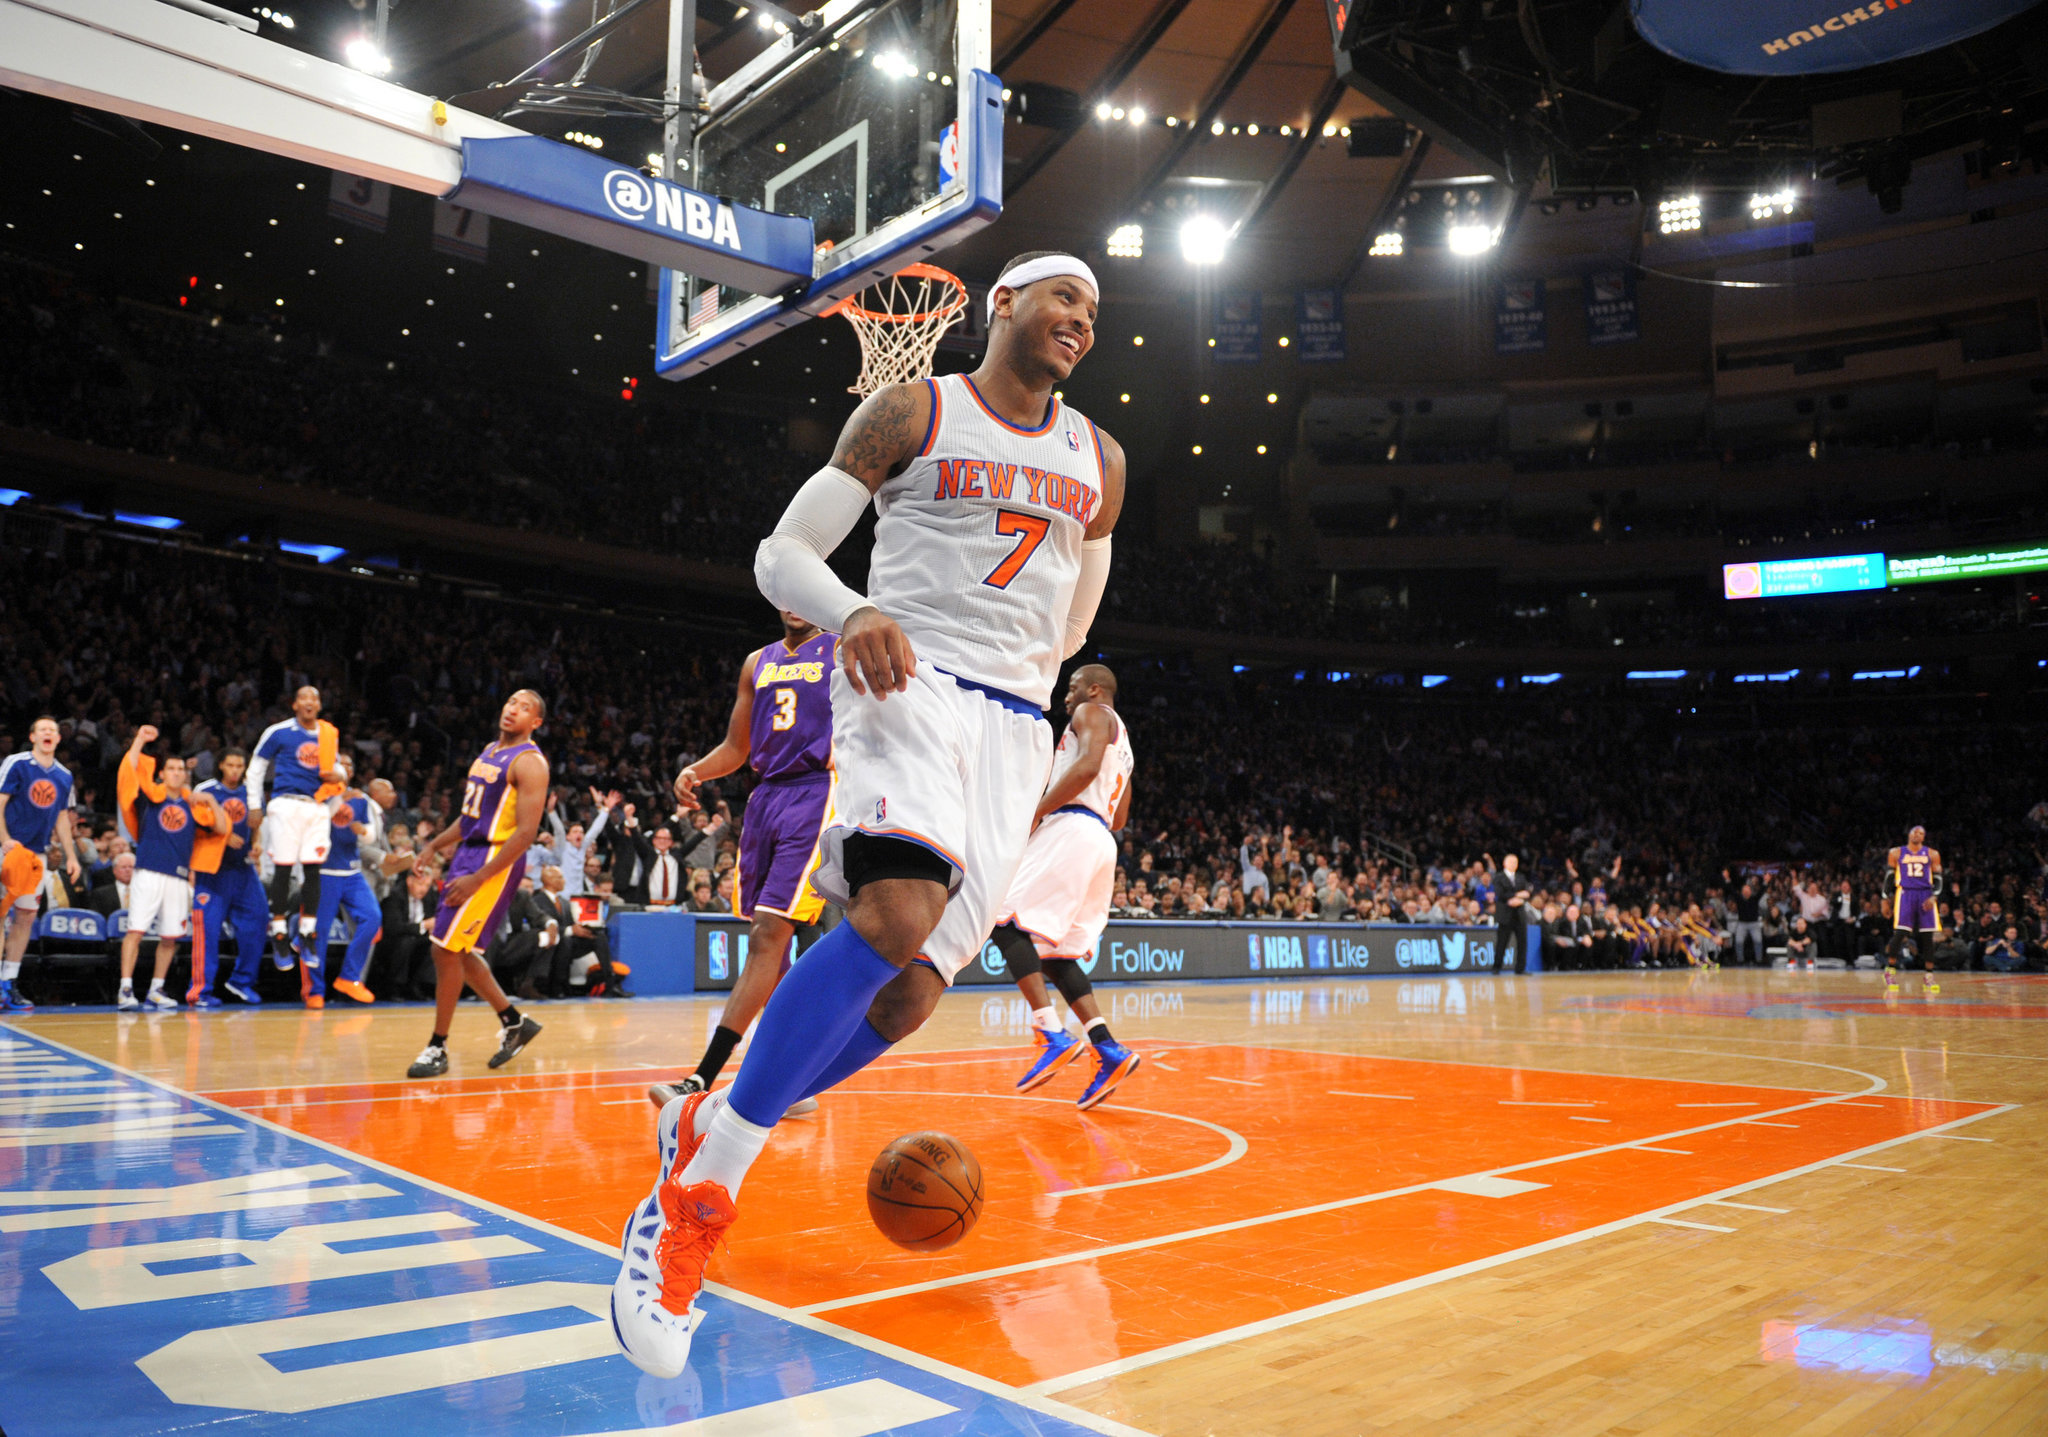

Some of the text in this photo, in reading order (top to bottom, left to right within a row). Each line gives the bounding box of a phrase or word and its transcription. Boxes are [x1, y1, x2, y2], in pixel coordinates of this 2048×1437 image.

[603, 170, 742, 251] @NBA
[935, 458, 1097, 530] NEW YORK
[982, 508, 1052, 590] 7
[756, 662, 824, 690] LAKERS
[773, 688, 797, 731] 3
[461, 780, 485, 819] 21
[1907, 863, 1924, 877] 12
[1111, 941, 1184, 973] Follow
[1264, 936, 1304, 969] NBA
[1332, 938, 1369, 968] Like
[1395, 938, 1514, 968] @NBA Follw
